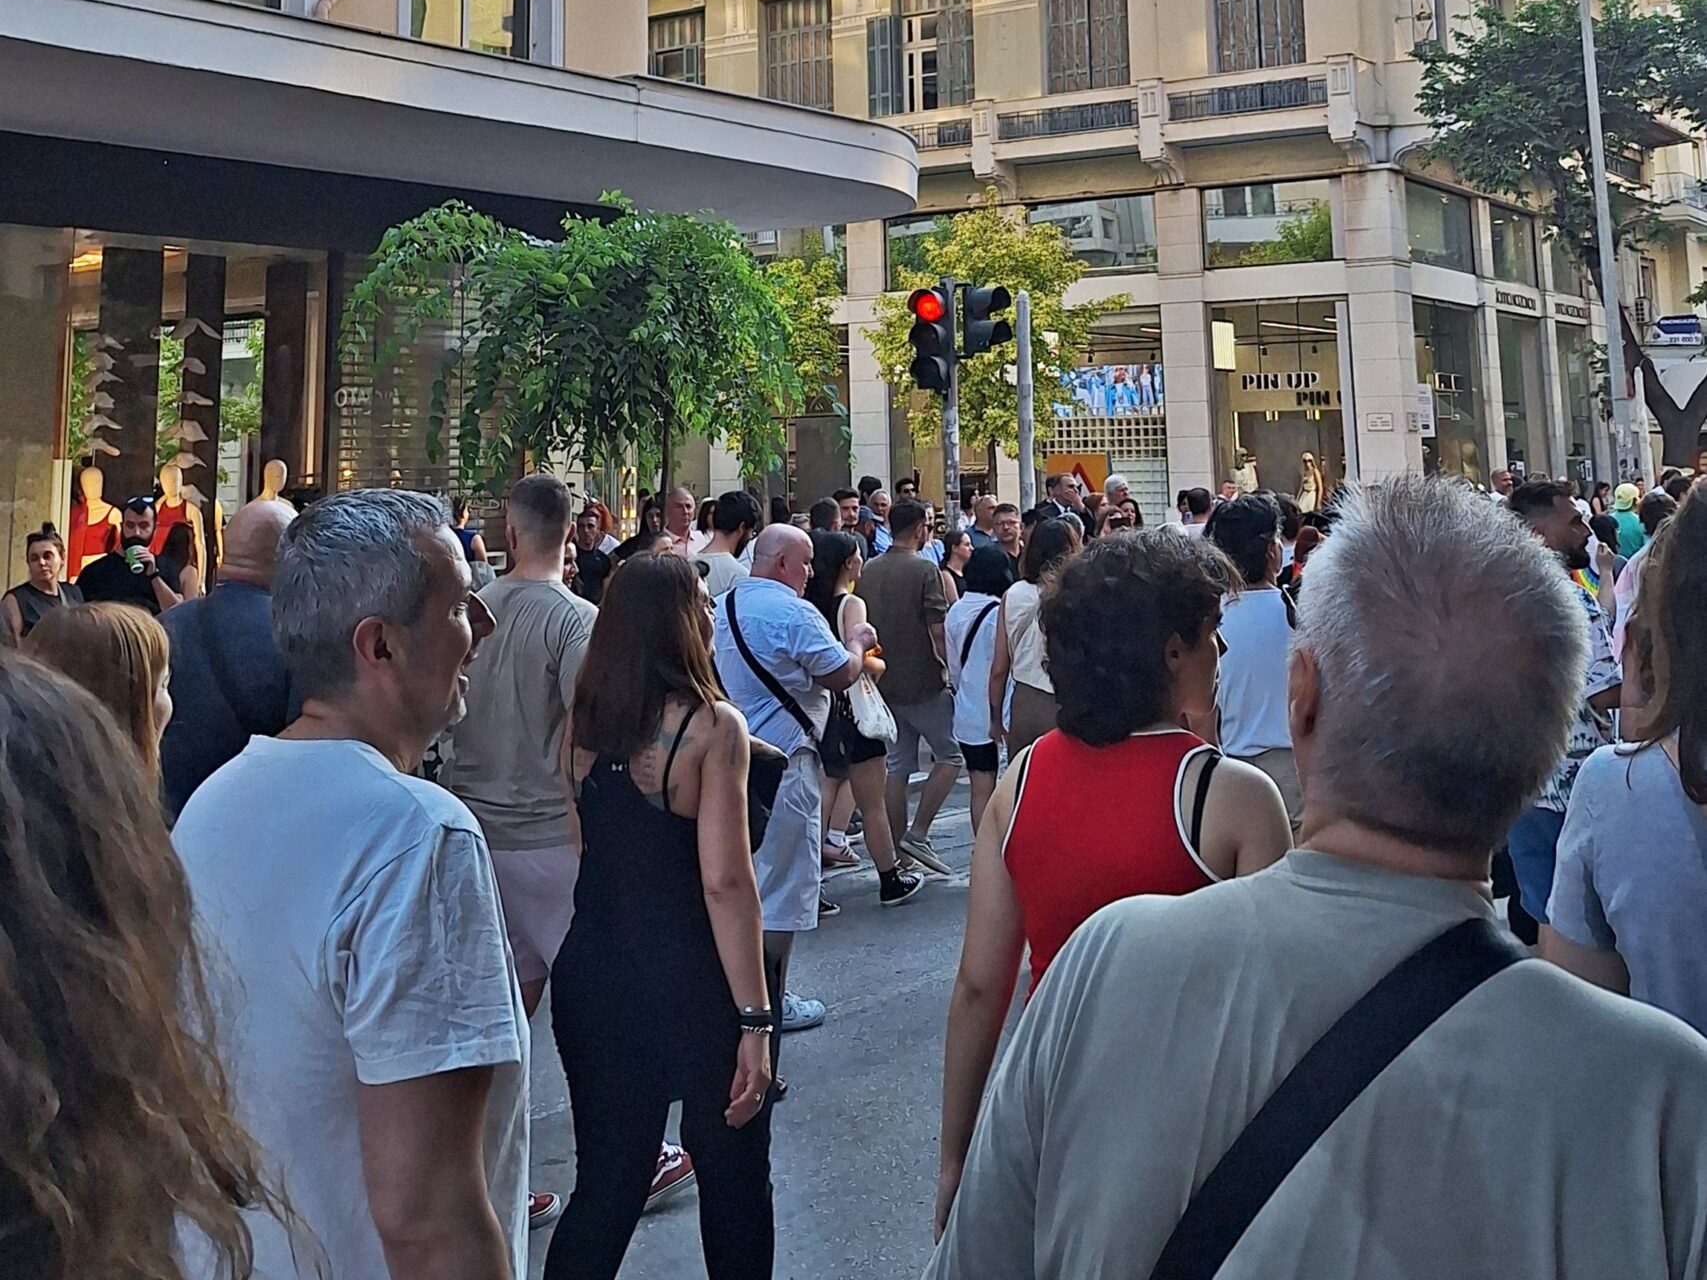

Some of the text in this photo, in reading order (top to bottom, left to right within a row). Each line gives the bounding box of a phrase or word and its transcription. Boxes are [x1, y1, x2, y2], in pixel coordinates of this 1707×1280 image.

[1241, 371, 1319, 391] PIN UP
[1296, 390, 1331, 406] PIN
